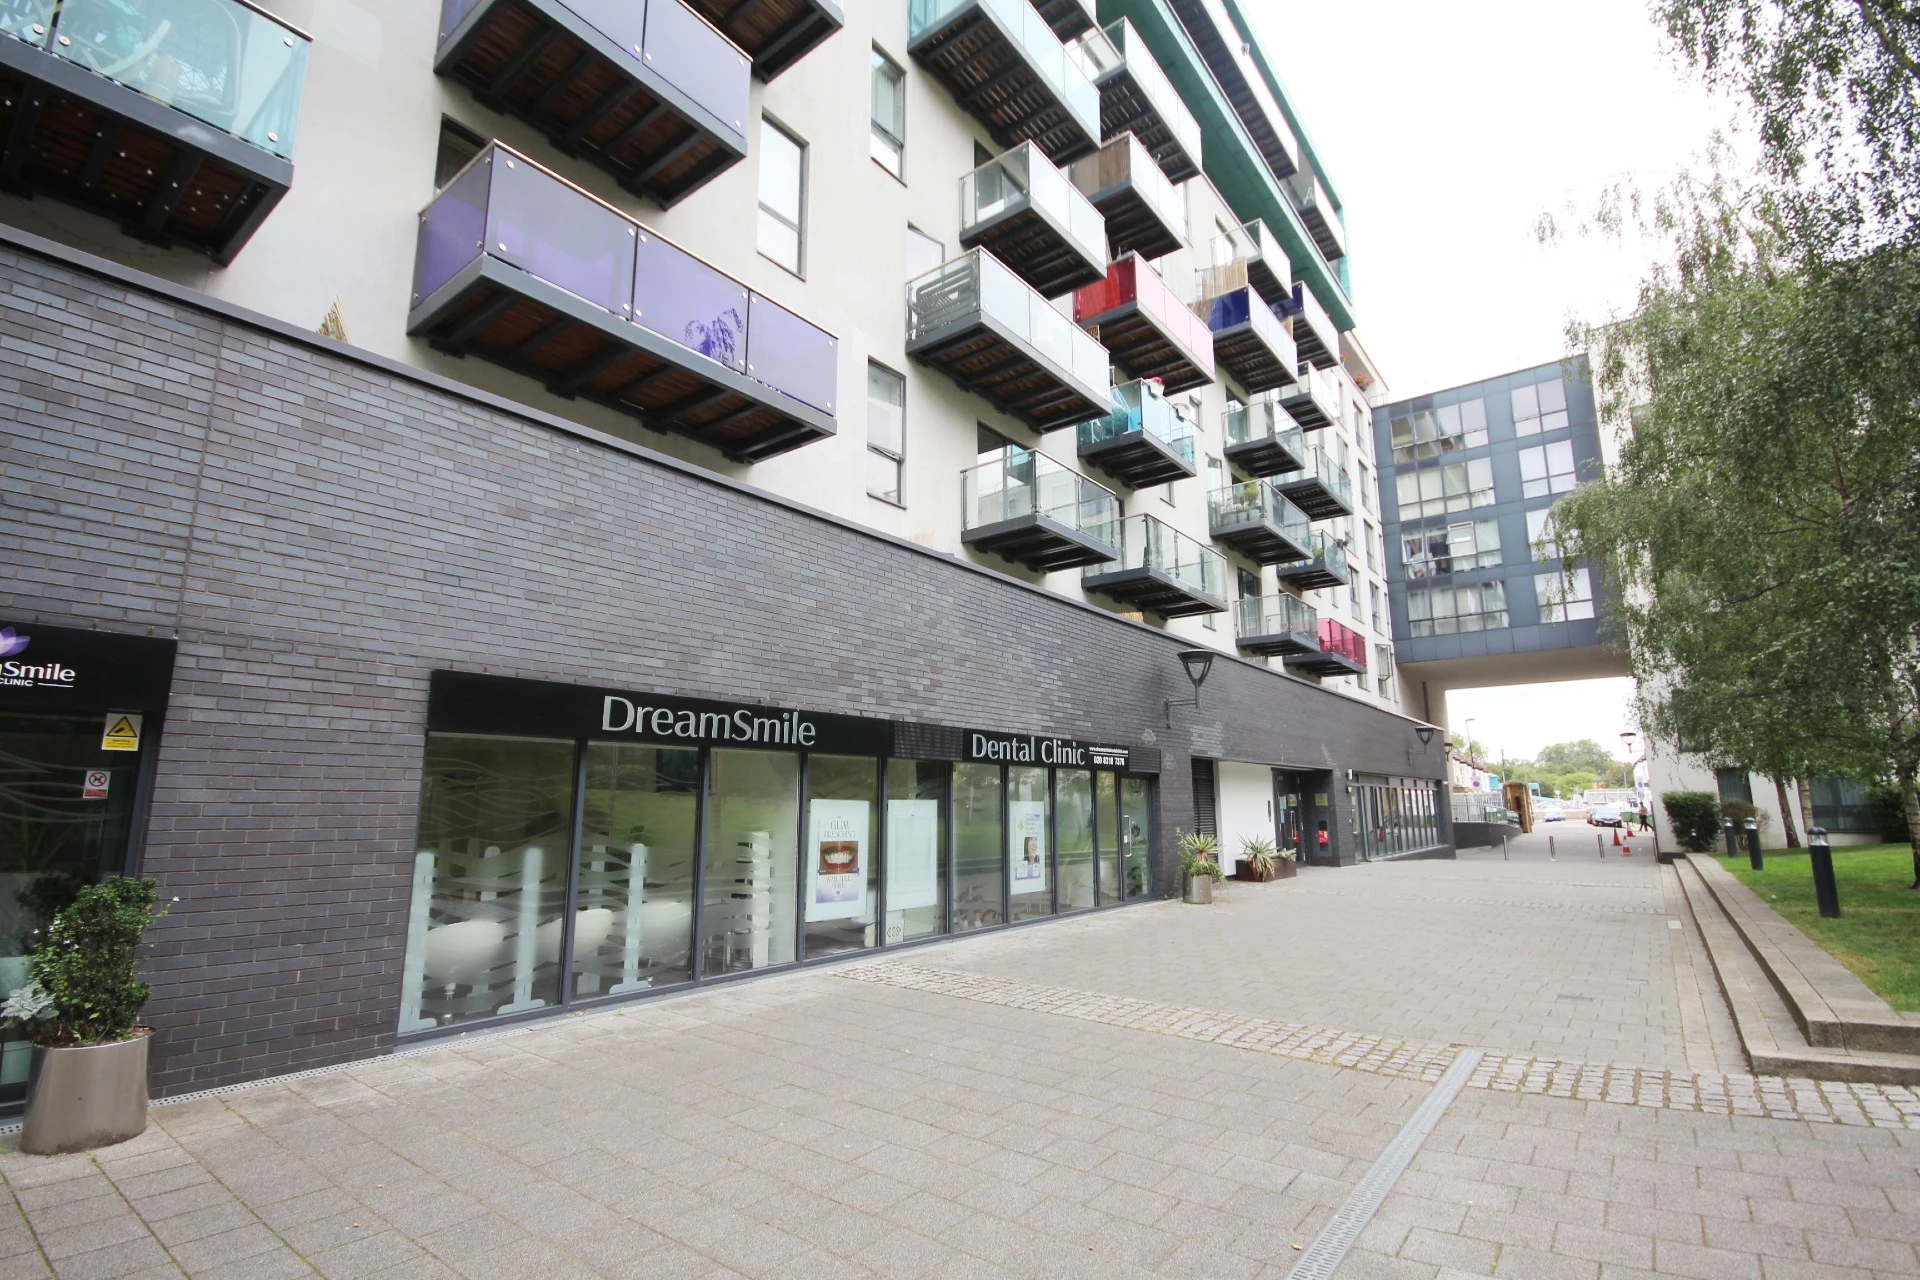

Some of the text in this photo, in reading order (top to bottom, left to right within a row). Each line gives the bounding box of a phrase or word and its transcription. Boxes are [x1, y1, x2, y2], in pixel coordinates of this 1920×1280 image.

[0, 661, 76, 682] Smile
[602, 695, 816, 746] DreamSmile
[972, 733, 1086, 766] Dental Clinic
